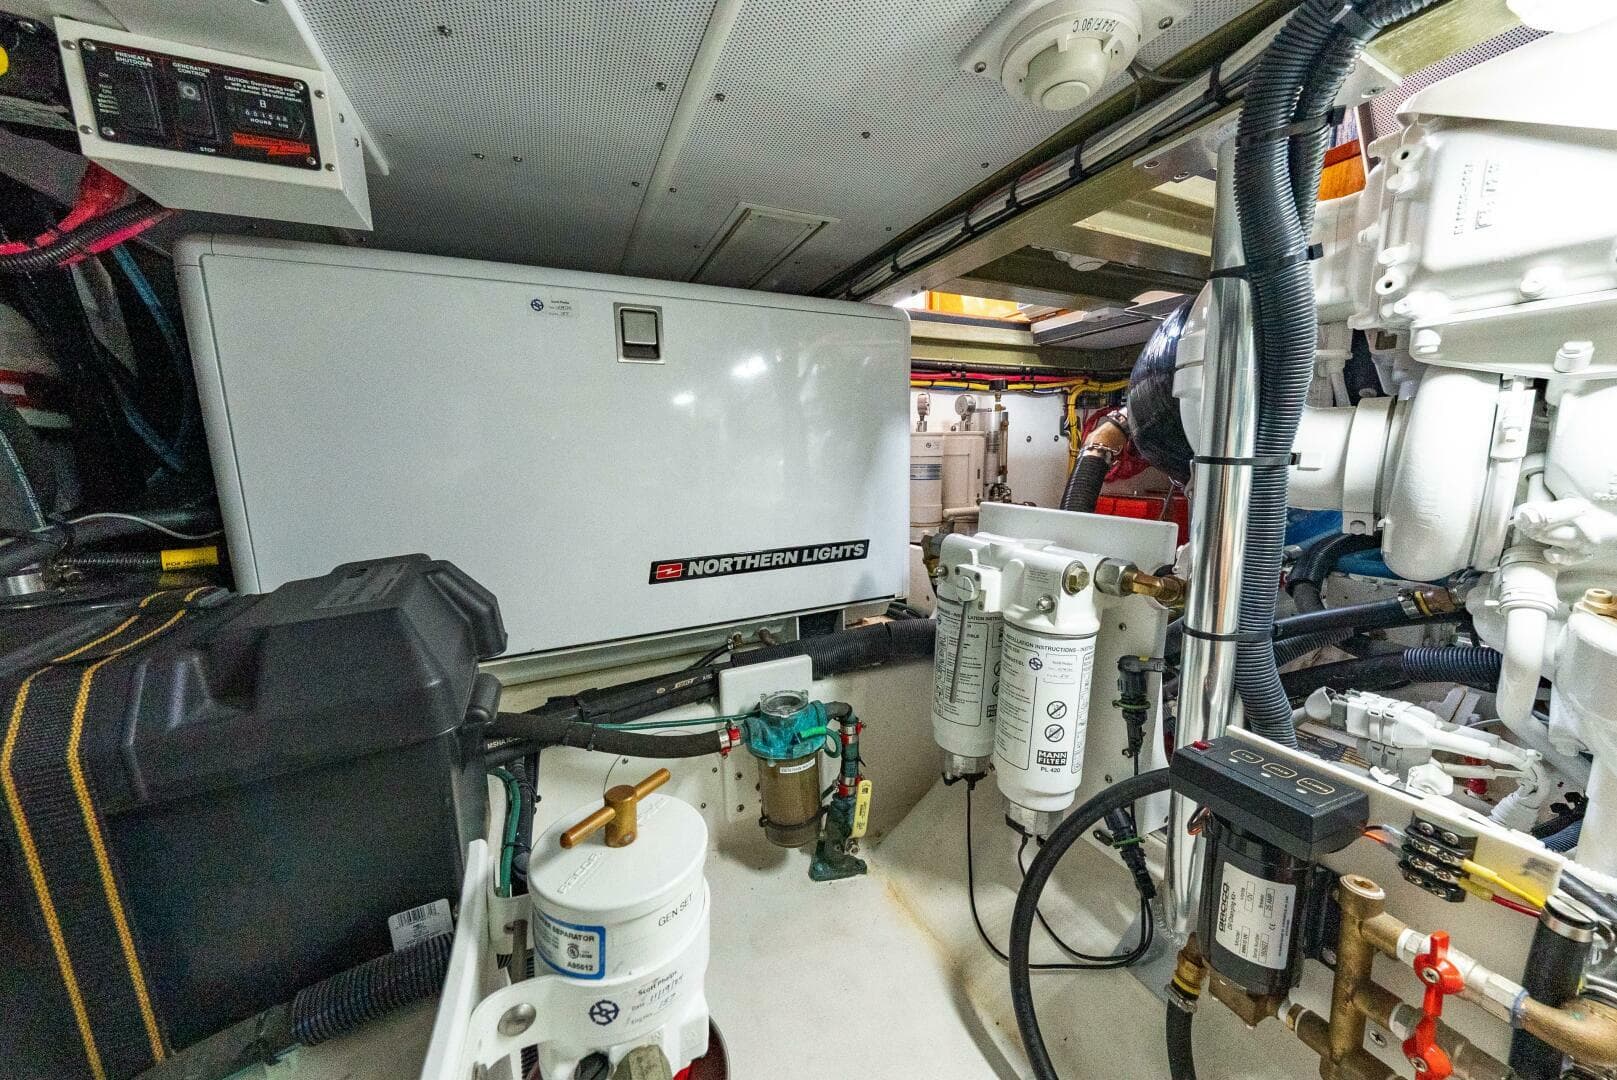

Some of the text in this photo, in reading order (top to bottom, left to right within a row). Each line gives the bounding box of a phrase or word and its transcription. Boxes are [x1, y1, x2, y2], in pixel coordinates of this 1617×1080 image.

[114, 51, 145, 61] PREHEAT
[115, 57, 153, 68] SHUTDOWN
[172, 62, 210, 73] GENERATOR
[177, 68, 208, 78] CONTROL
[250, 118, 272, 126] HOURS
[199, 146, 216, 154] STOP
[688, 544, 865, 576] NORTHERN LIGHTS
[1034, 643, 1076, 653] INSTRUCTIONS
[658, 893, 692, 927] GEN SET
[1218, 882, 1230, 933] GROCO
[1228, 902, 1236, 923] Changing
[552, 926, 594, 942] SEPARATOR
[638, 984, 656, 995] Scott
